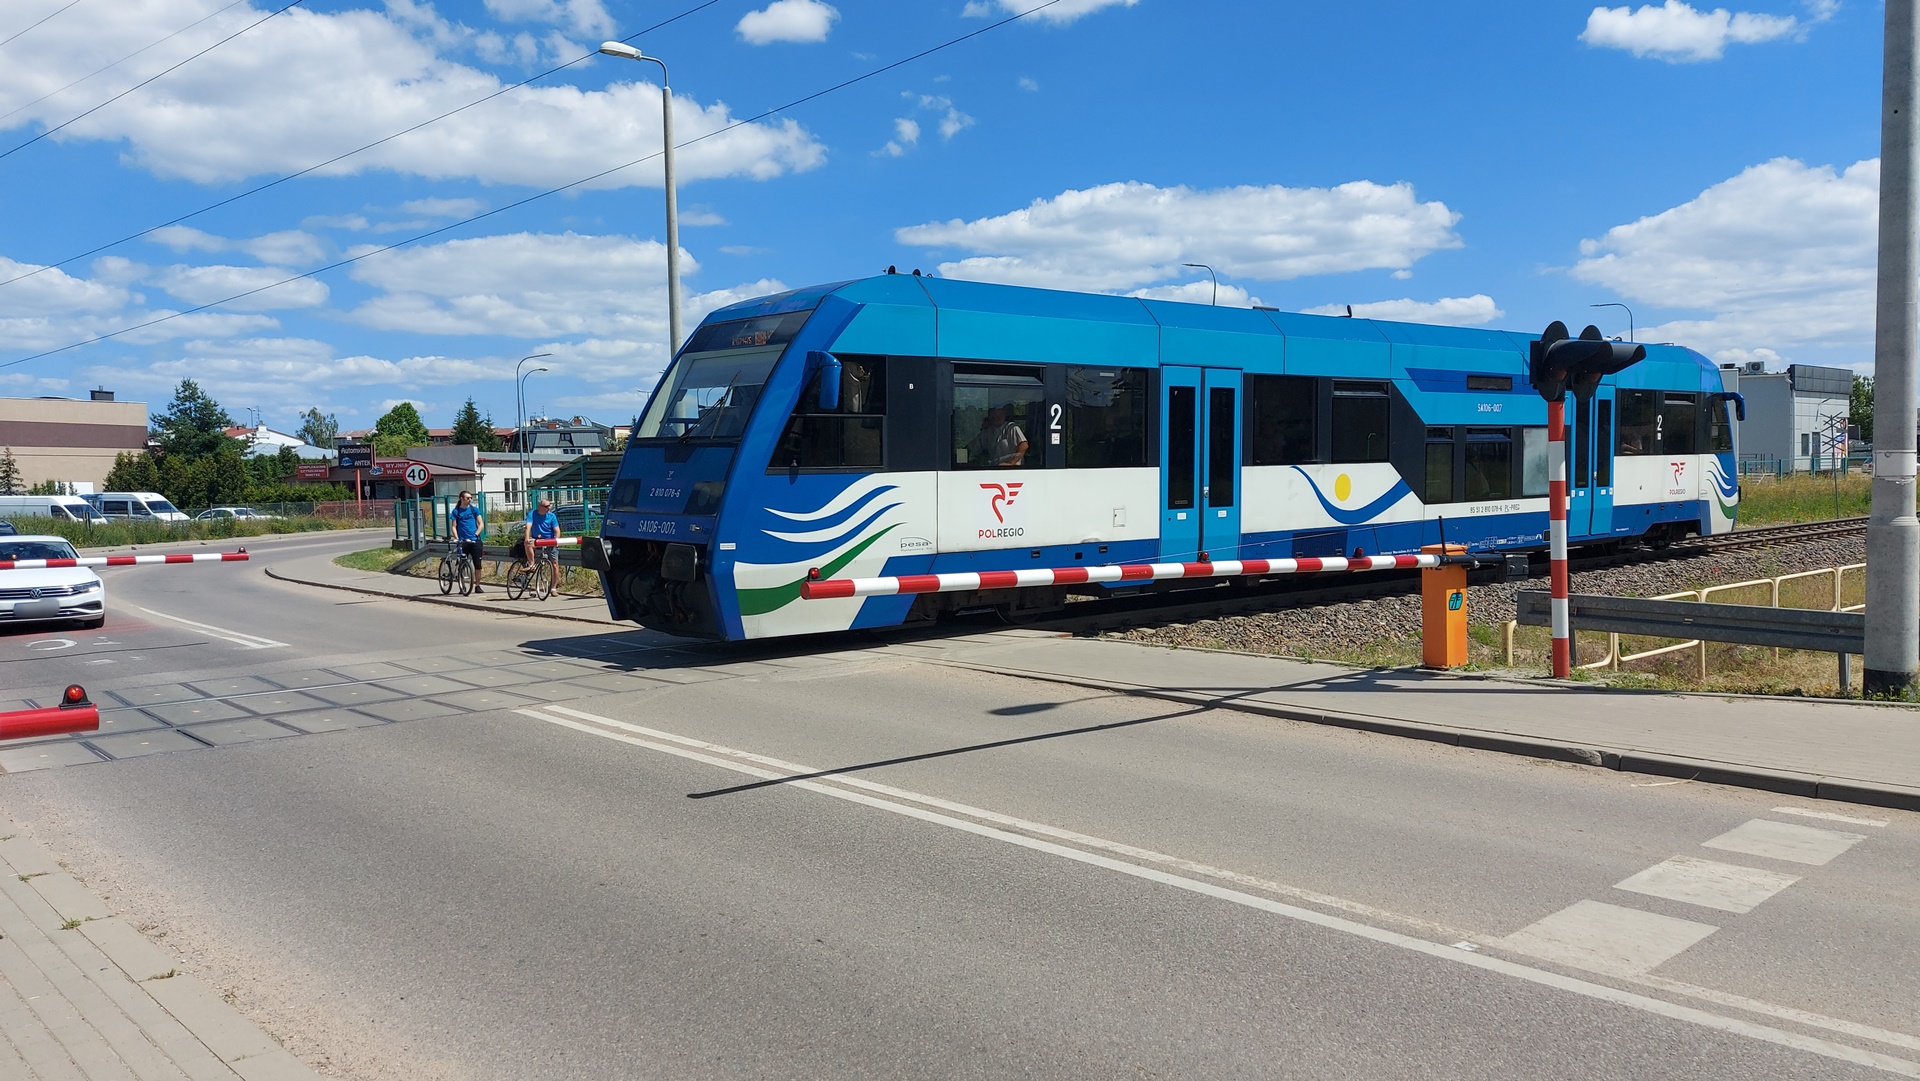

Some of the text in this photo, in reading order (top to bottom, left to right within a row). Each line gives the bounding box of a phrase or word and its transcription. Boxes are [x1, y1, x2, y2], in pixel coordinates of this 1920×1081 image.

[1477, 403, 1503, 412] SA106-007
[1050, 403, 1062, 430] 2
[1657, 414, 1662, 431] 2
[407, 468, 427, 481] 40
[650, 487, 655, 497] 2
[978, 527, 1025, 539] POLREGIO
[900, 541, 929, 549] pesa
